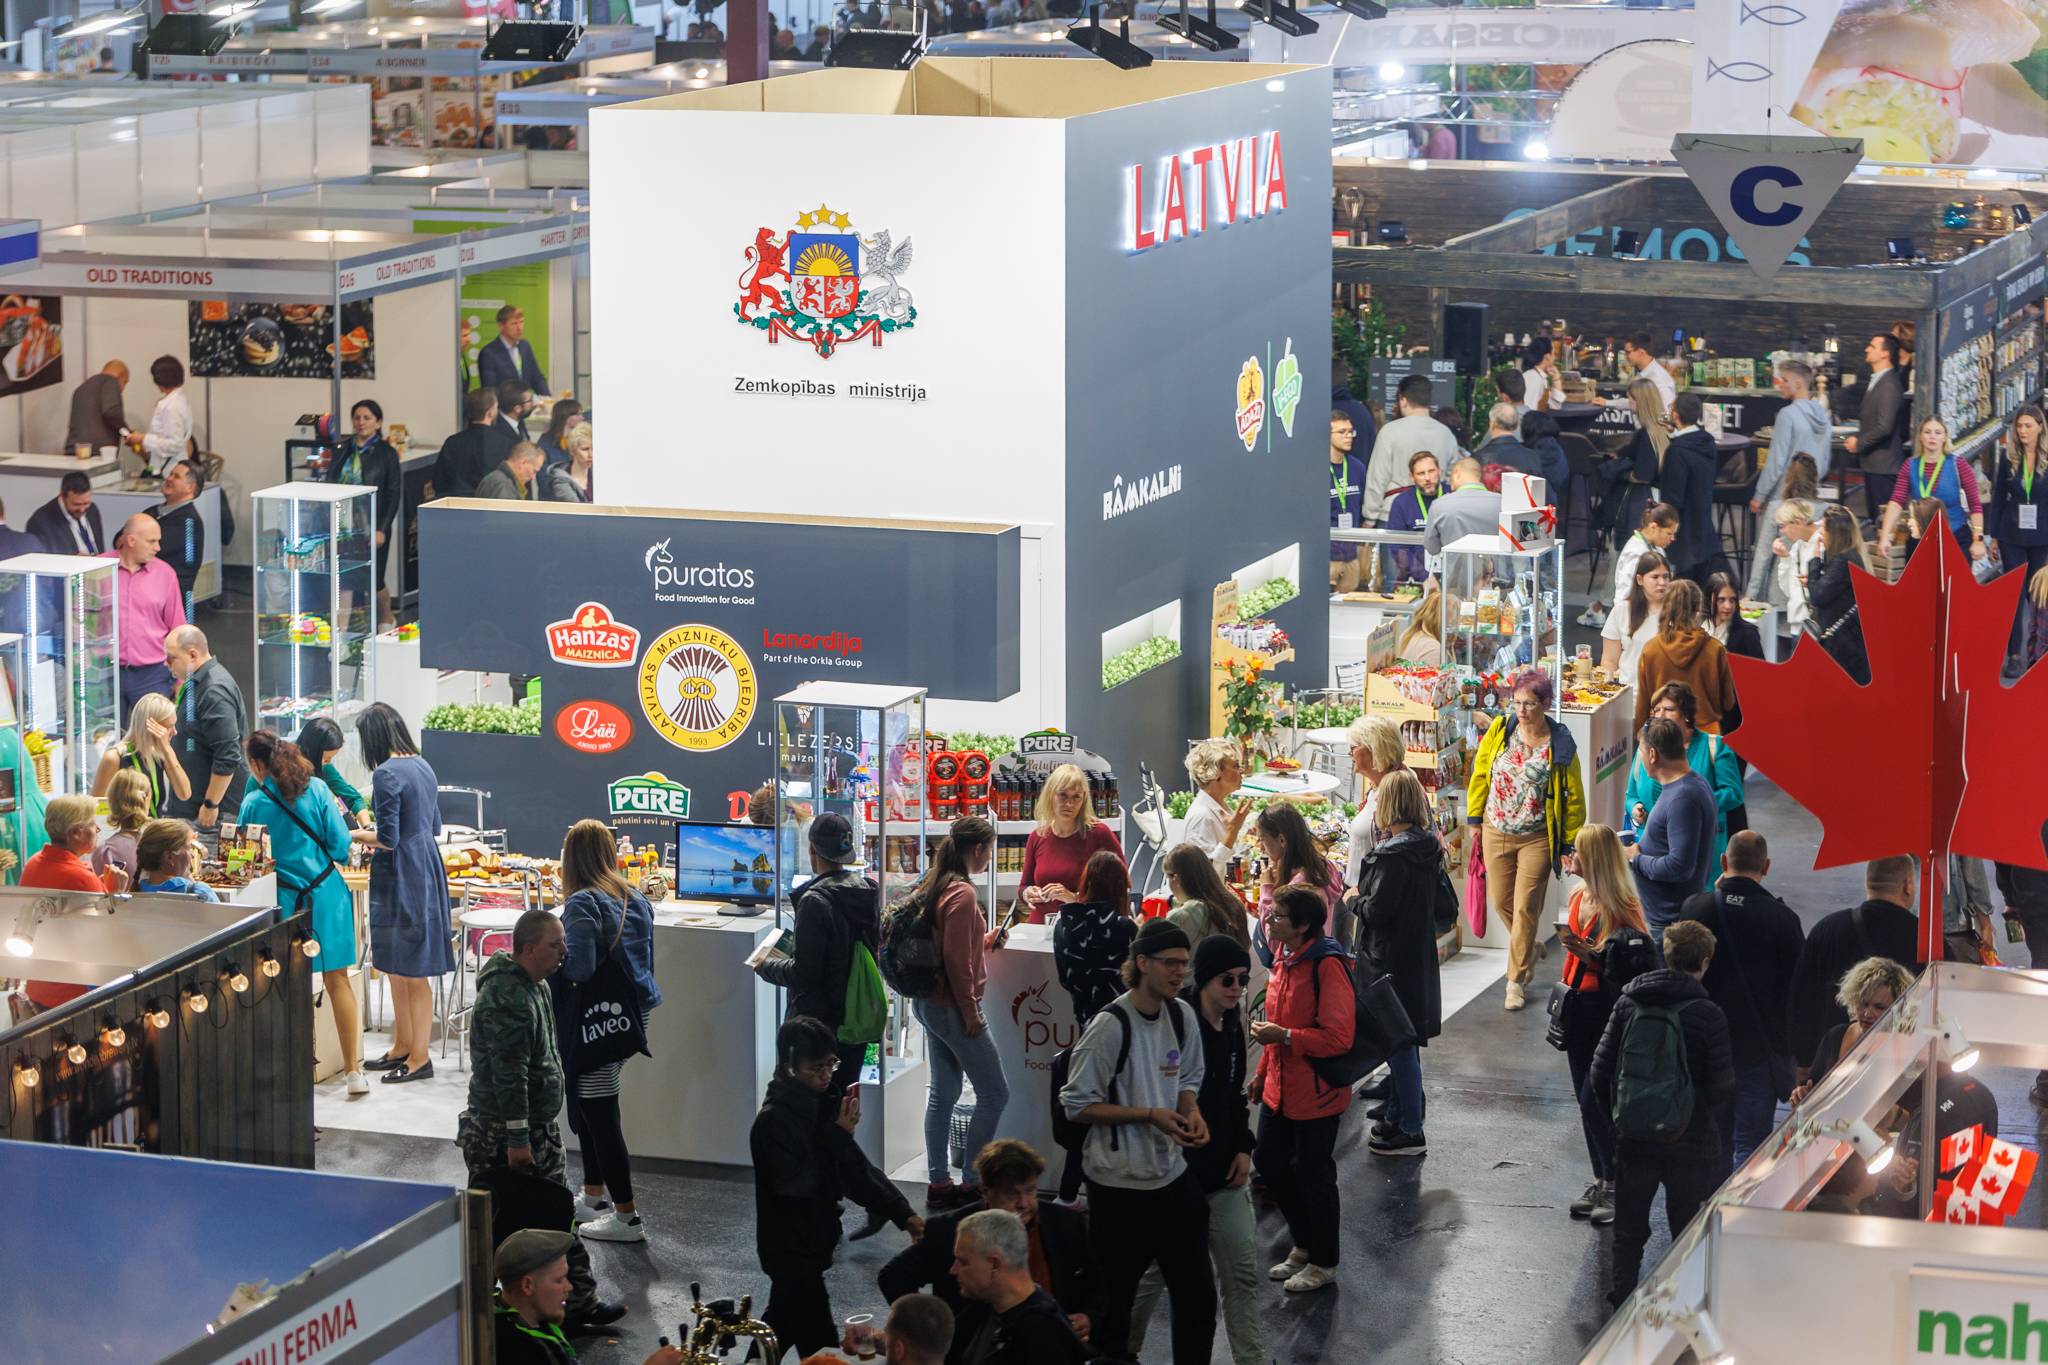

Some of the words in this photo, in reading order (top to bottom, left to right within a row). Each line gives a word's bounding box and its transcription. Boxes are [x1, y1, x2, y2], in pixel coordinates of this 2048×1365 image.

[1133, 130, 1288, 250] LATVIA
[1730, 165, 1803, 226] C
[87, 268, 117, 283] OLD
[122, 269, 214, 285] TRADITIONS
[376, 265, 391, 281] OLD
[393, 254, 436, 276] TRADITIONS
[339, 274, 355, 289] D16
[734, 376, 836, 398] Zemkopības
[849, 381, 927, 401] ministrija
[654, 562, 755, 590] puratos
[655, 593, 675, 602] Food
[676, 594, 718, 604] Innovation
[719, 594, 731, 604] for
[732, 596, 755, 605] Good
[554, 628, 631, 651] Hanzas
[656, 631, 739, 659] MAIZNIEKU
[763, 653, 781, 663] Part
[782, 654, 795, 664] of
[796, 655, 808, 664] the
[809, 656, 833, 666] Orkla
[834, 657, 863, 669] Group
[644, 663, 678, 738] LATVIJAS
[570, 707, 618, 739] Lāči
[576, 741, 597, 751] ANNO
[688, 736, 708, 746] 1993
[612, 817, 642, 827] palutini
[643, 817, 658, 826] sevi
[1726, 894, 1744, 905] EA7
[582, 1016, 631, 1043] laveo
[284, 1298, 357, 1365] FERMA
